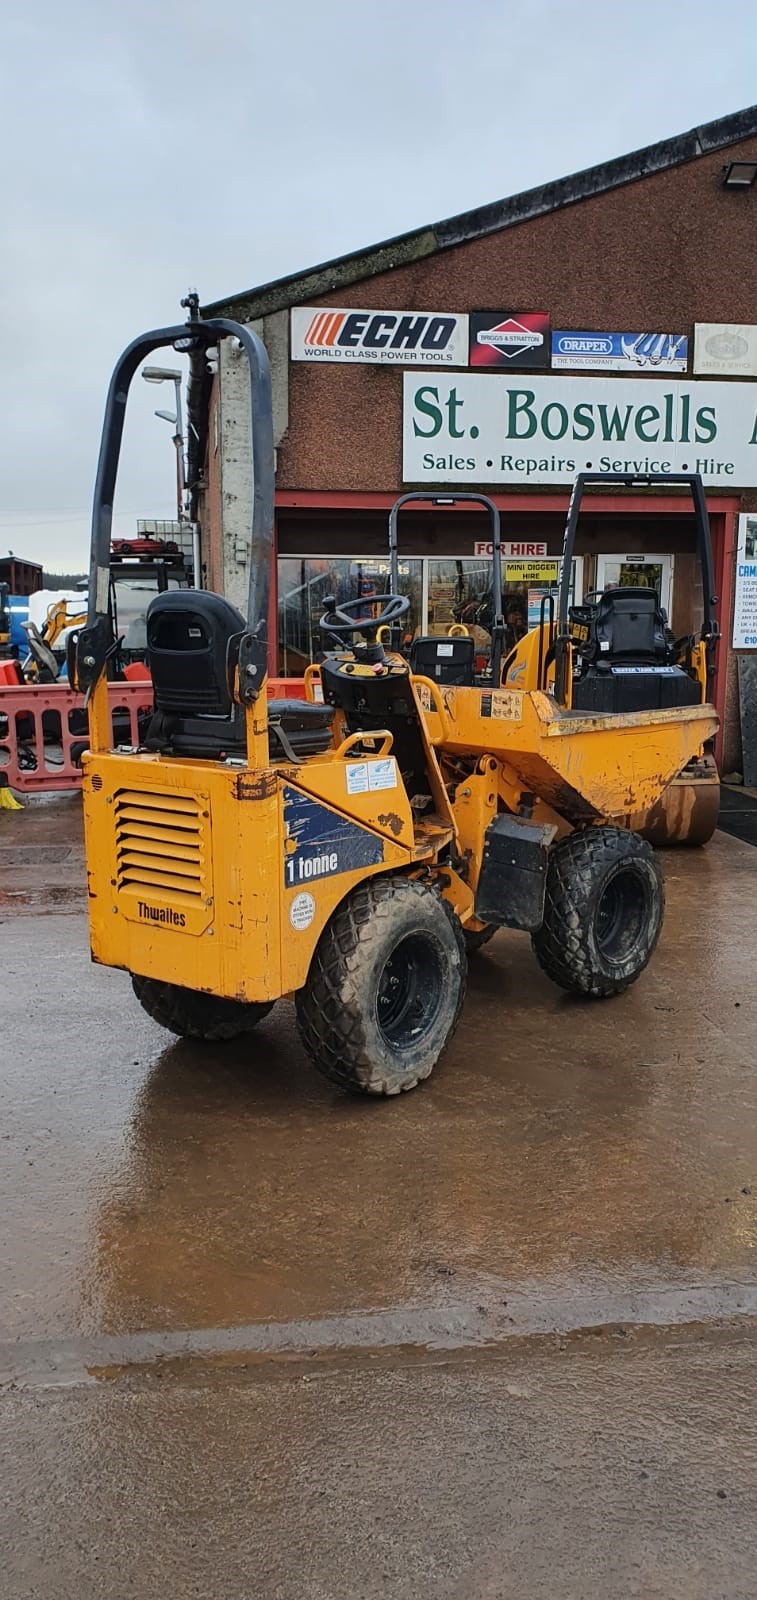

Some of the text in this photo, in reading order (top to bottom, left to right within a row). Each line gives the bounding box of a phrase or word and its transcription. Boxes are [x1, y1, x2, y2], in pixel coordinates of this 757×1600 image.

[337, 314, 457, 350] ECHO
[304, 349, 453, 361] WORLD CLASS POWER TOOLS
[563, 340, 607, 352] DRAPER
[412, 386, 480, 439] St.
[505, 389, 718, 444] Boswells
[423, 453, 735, 475] Sales Repairs Service Hire
[477, 543, 545, 556] FOR HIRE
[379, 564, 410, 575] Pats
[287, 852, 338, 882] 1 tonne
[137, 901, 186, 927] Thwaites
